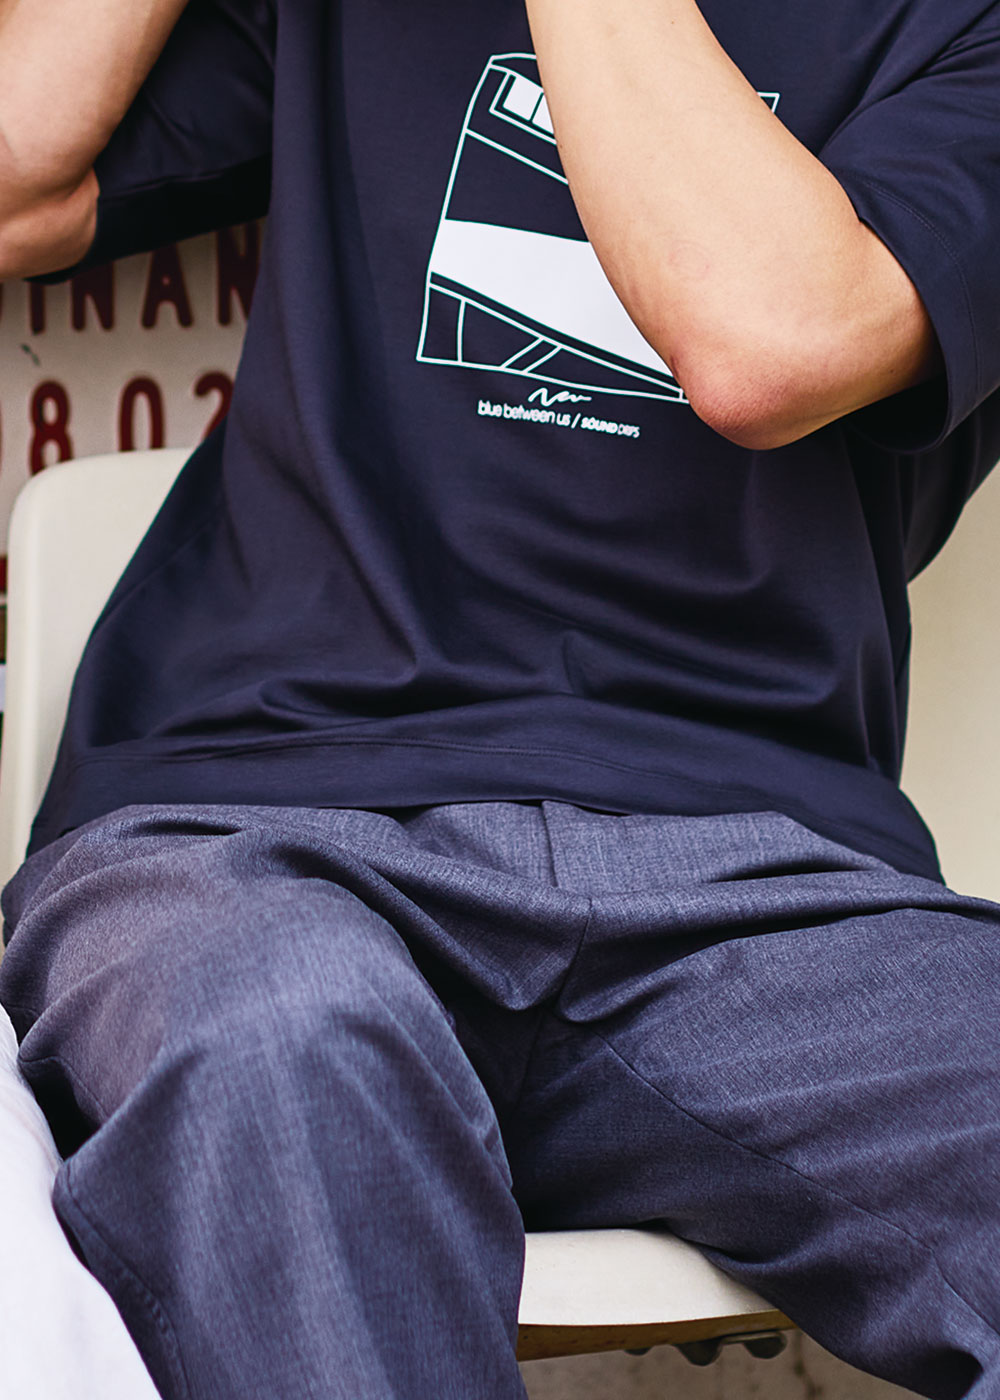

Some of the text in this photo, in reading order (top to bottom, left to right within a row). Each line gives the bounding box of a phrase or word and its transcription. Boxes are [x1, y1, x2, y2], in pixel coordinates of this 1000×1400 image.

[478, 400, 502, 416] blue
[503, 403, 556, 423] between
[556, 413, 571, 426] us
